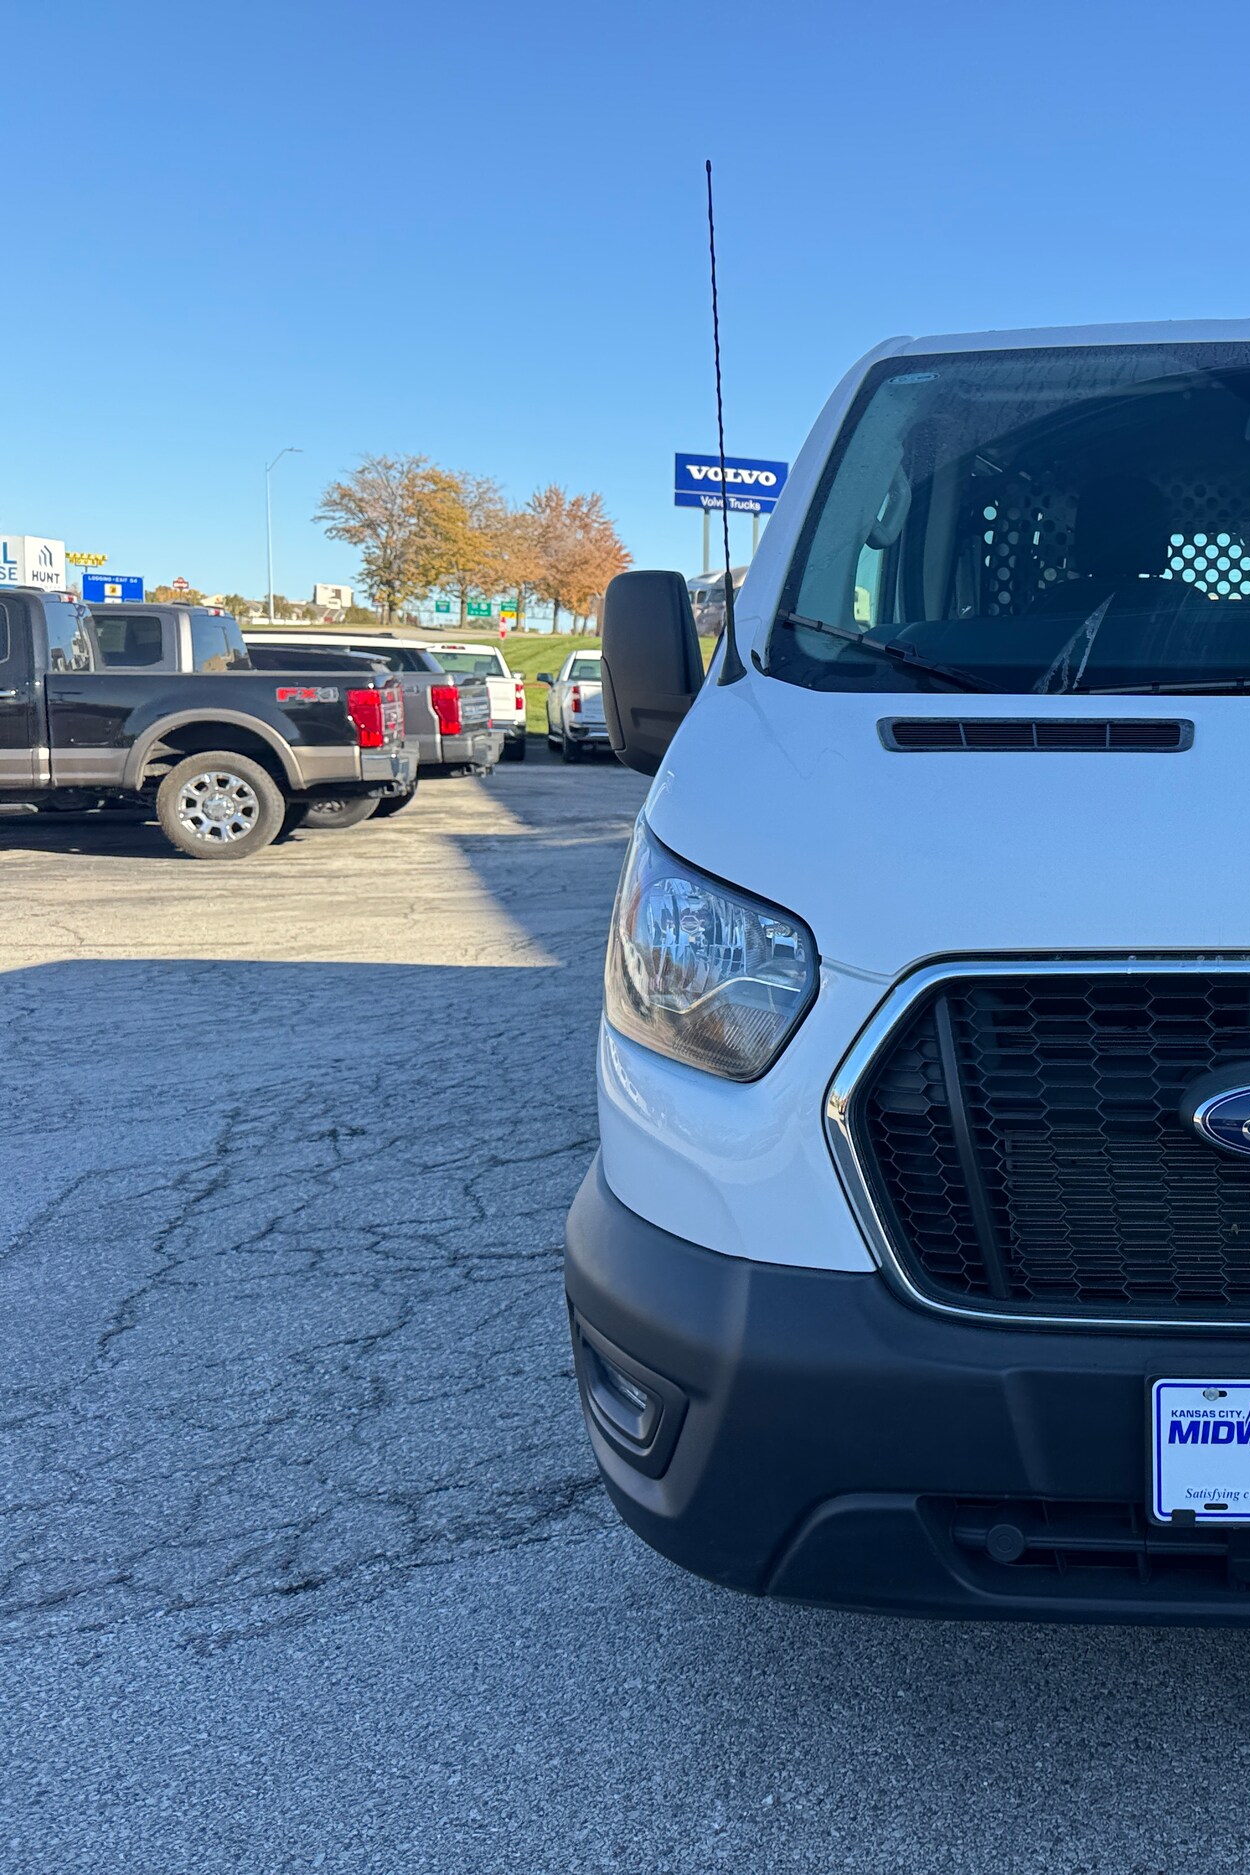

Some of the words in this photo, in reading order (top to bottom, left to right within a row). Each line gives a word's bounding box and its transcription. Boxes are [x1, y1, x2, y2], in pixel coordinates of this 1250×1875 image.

[686, 464, 777, 487] VOLVO
[729, 498, 761, 511] Trucks
[31, 570, 61, 584] HUNT
[276, 686, 340, 703] FX4
[1171, 1409, 1216, 1418] KANSAS
[1218, 1409, 1245, 1420] CITY,
[1185, 1487, 1240, 1502] Satisfying
